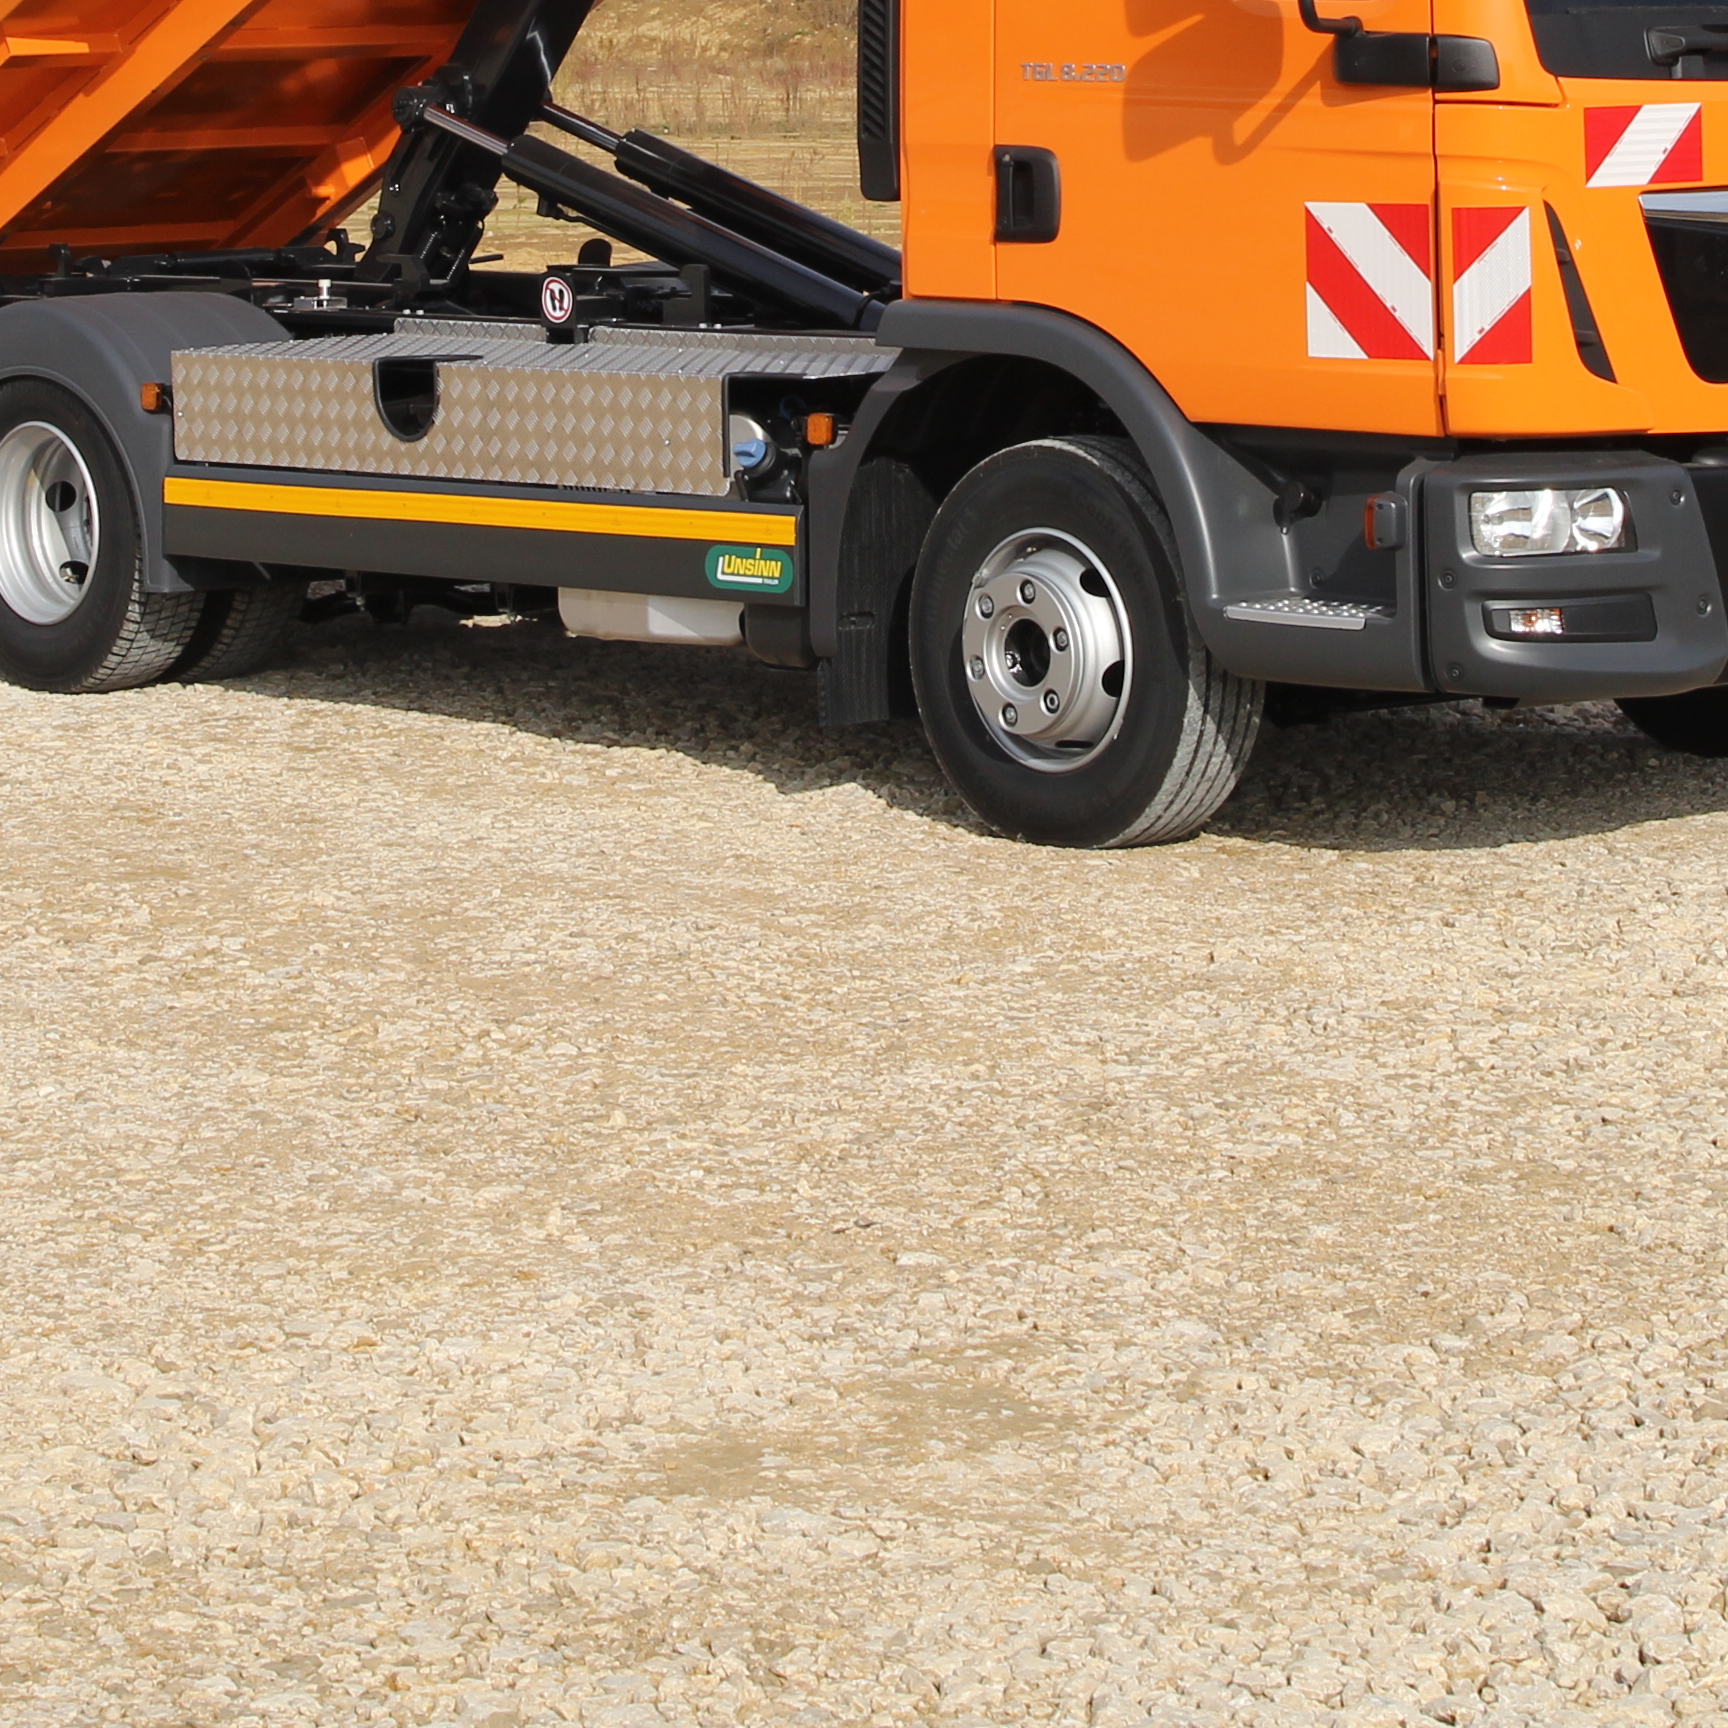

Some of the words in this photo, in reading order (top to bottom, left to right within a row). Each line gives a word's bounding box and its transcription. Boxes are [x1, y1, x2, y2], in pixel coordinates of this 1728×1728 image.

[1020, 62, 1058, 81] TGL
[1060, 63, 1127, 83] 8.220
[721, 547, 782, 579] UNSINN
